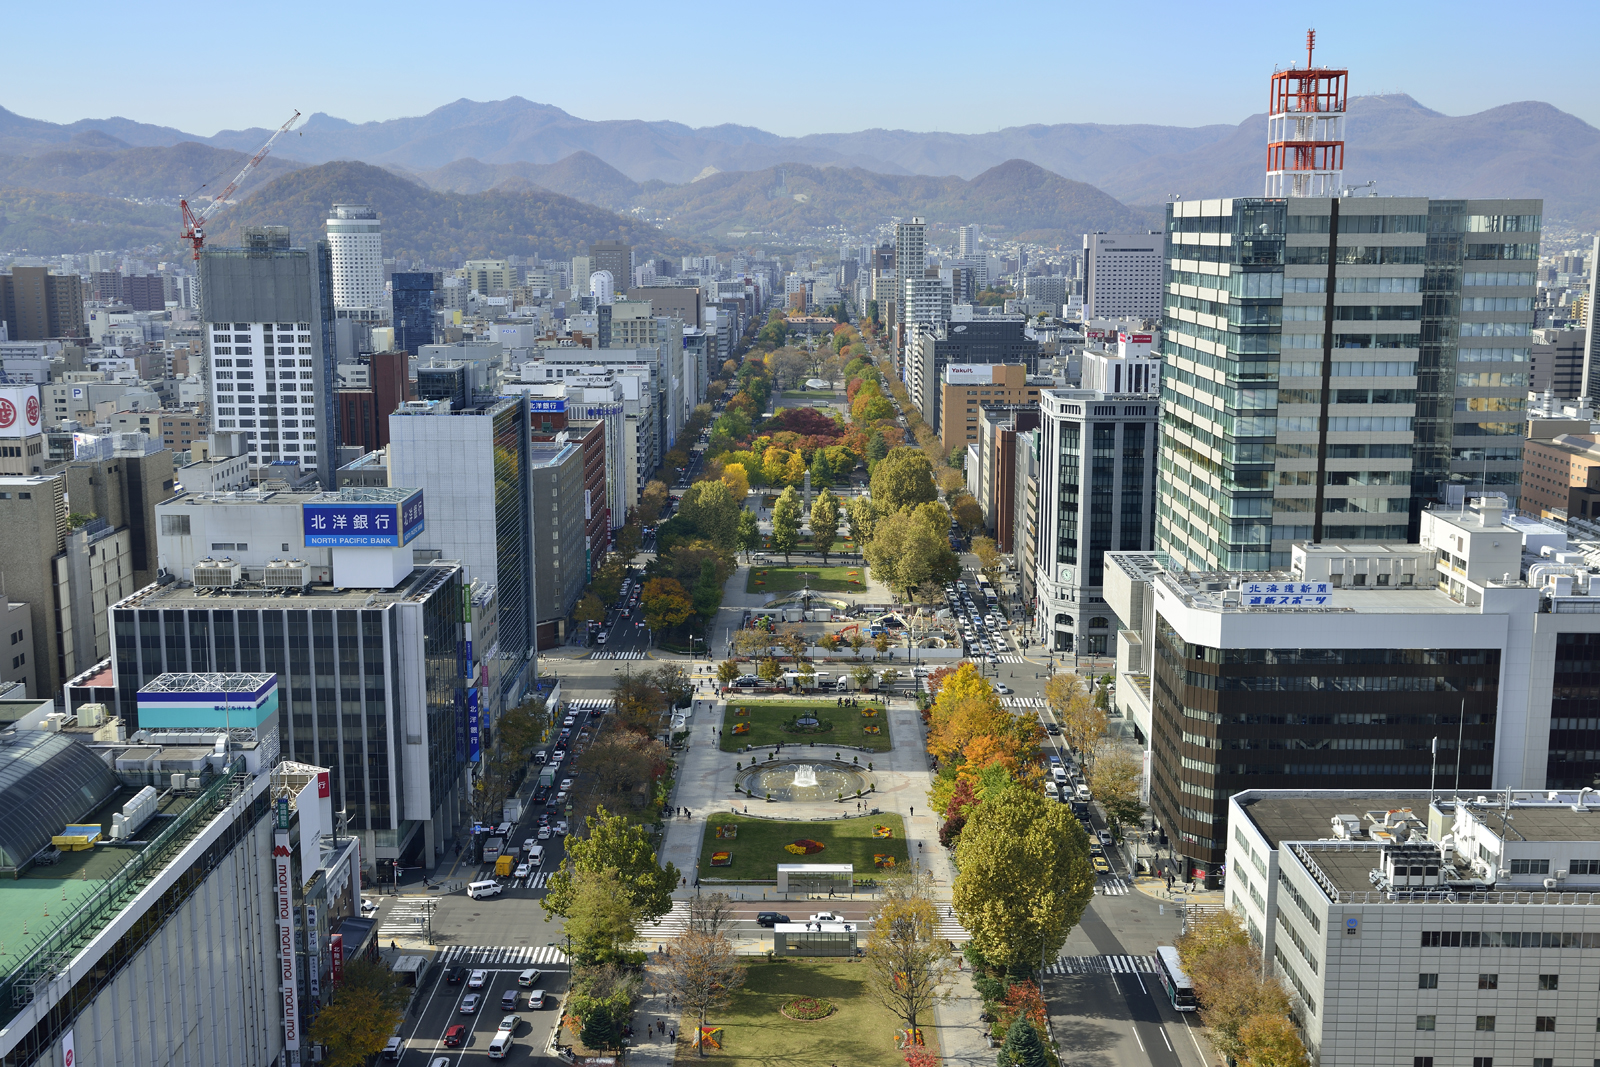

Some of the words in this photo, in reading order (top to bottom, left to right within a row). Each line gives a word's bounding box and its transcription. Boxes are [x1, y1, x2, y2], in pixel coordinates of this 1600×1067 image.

[73, 388, 81, 398] P
[311, 514, 390, 530] 北洋銀行
[1248, 583, 1327, 593] 北海道新聞
[1248, 595, 1327, 605] 道新スポーツ
[469, 705, 478, 745] 北洋銀行
[278, 864, 288, 896] marui
[280, 897, 289, 920] imai
[281, 926, 291, 957] marui
[283, 958, 292, 981] imai
[284, 987, 294, 1017] marui
[286, 1019, 295, 1041] imai
